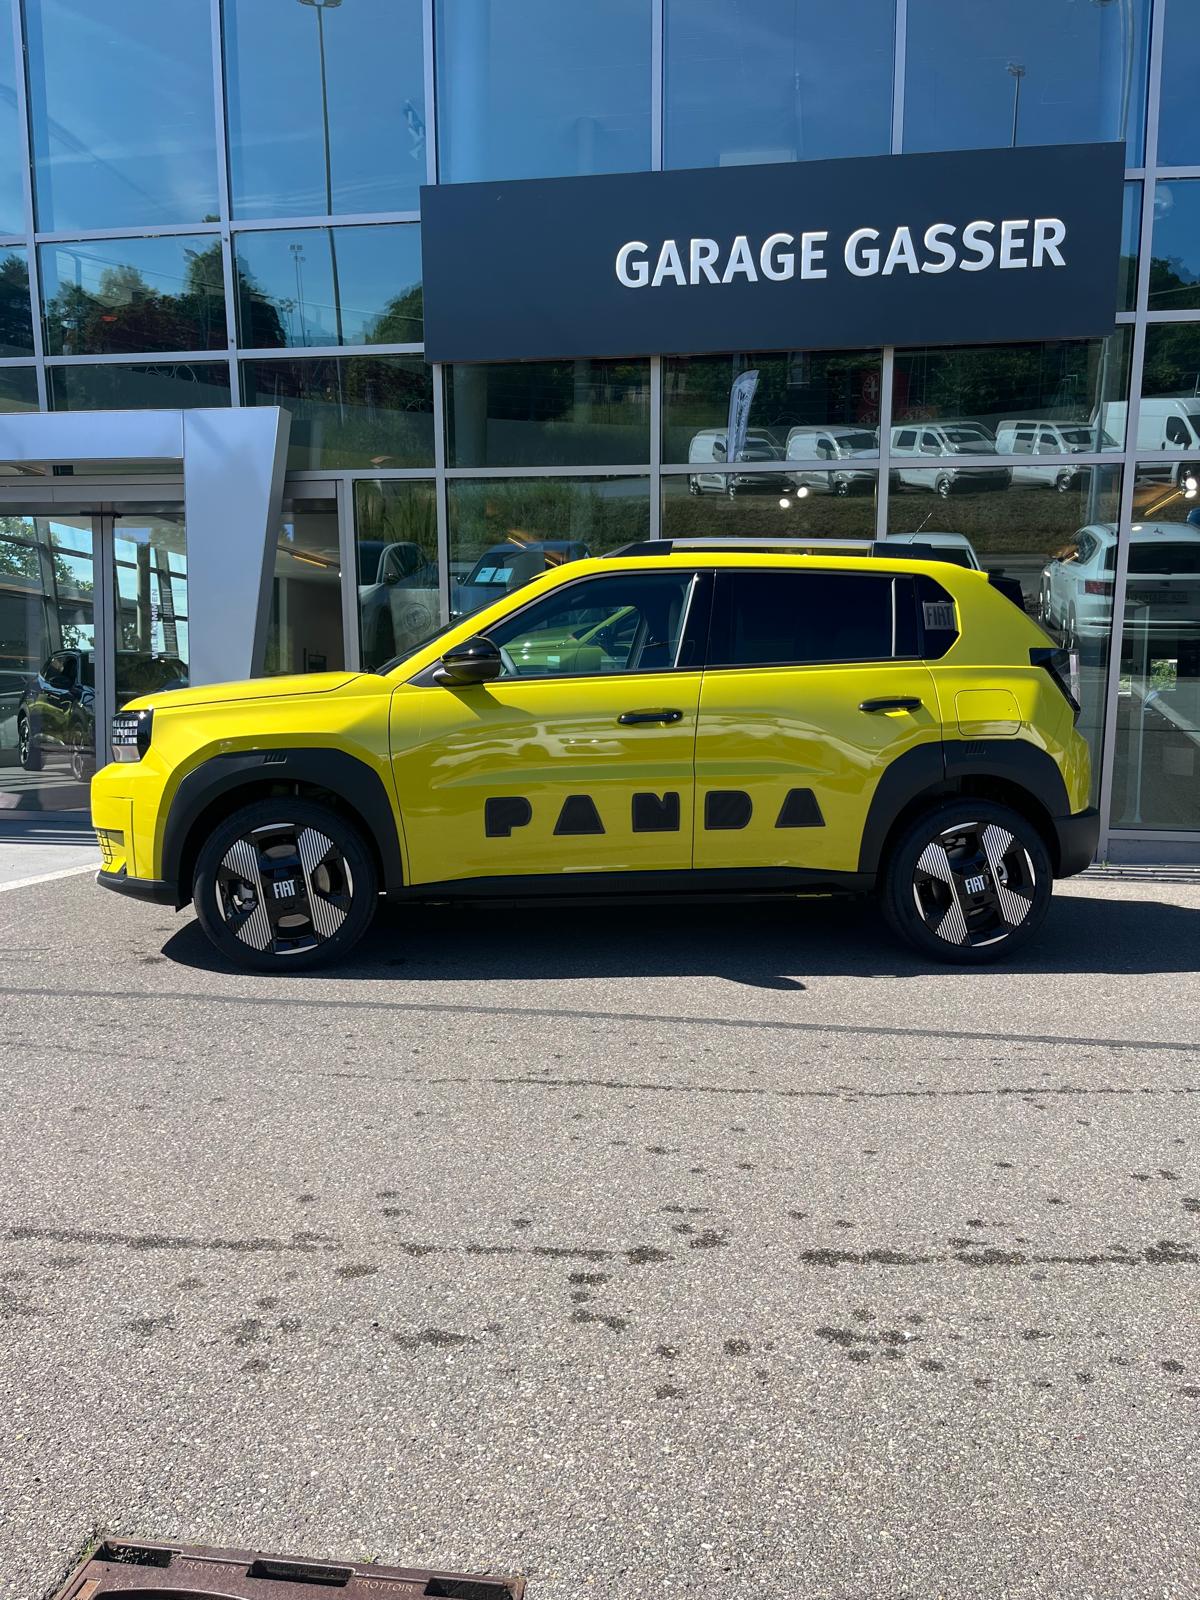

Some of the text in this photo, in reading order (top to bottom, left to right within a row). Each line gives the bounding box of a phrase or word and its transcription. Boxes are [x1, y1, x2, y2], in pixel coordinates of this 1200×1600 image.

[615, 218, 1067, 289] GARAGE GASSER
[150, 588, 159, 660] WILLKOMMEN
[926, 605, 953, 626] FIAT
[484, 787, 826, 838] PANDA
[272, 879, 296, 899] FIAT
[964, 874, 986, 895] FIAT
[181, 1561, 236, 1574] TROTTOIR
[355, 1579, 413, 1593] TROTTOIR
